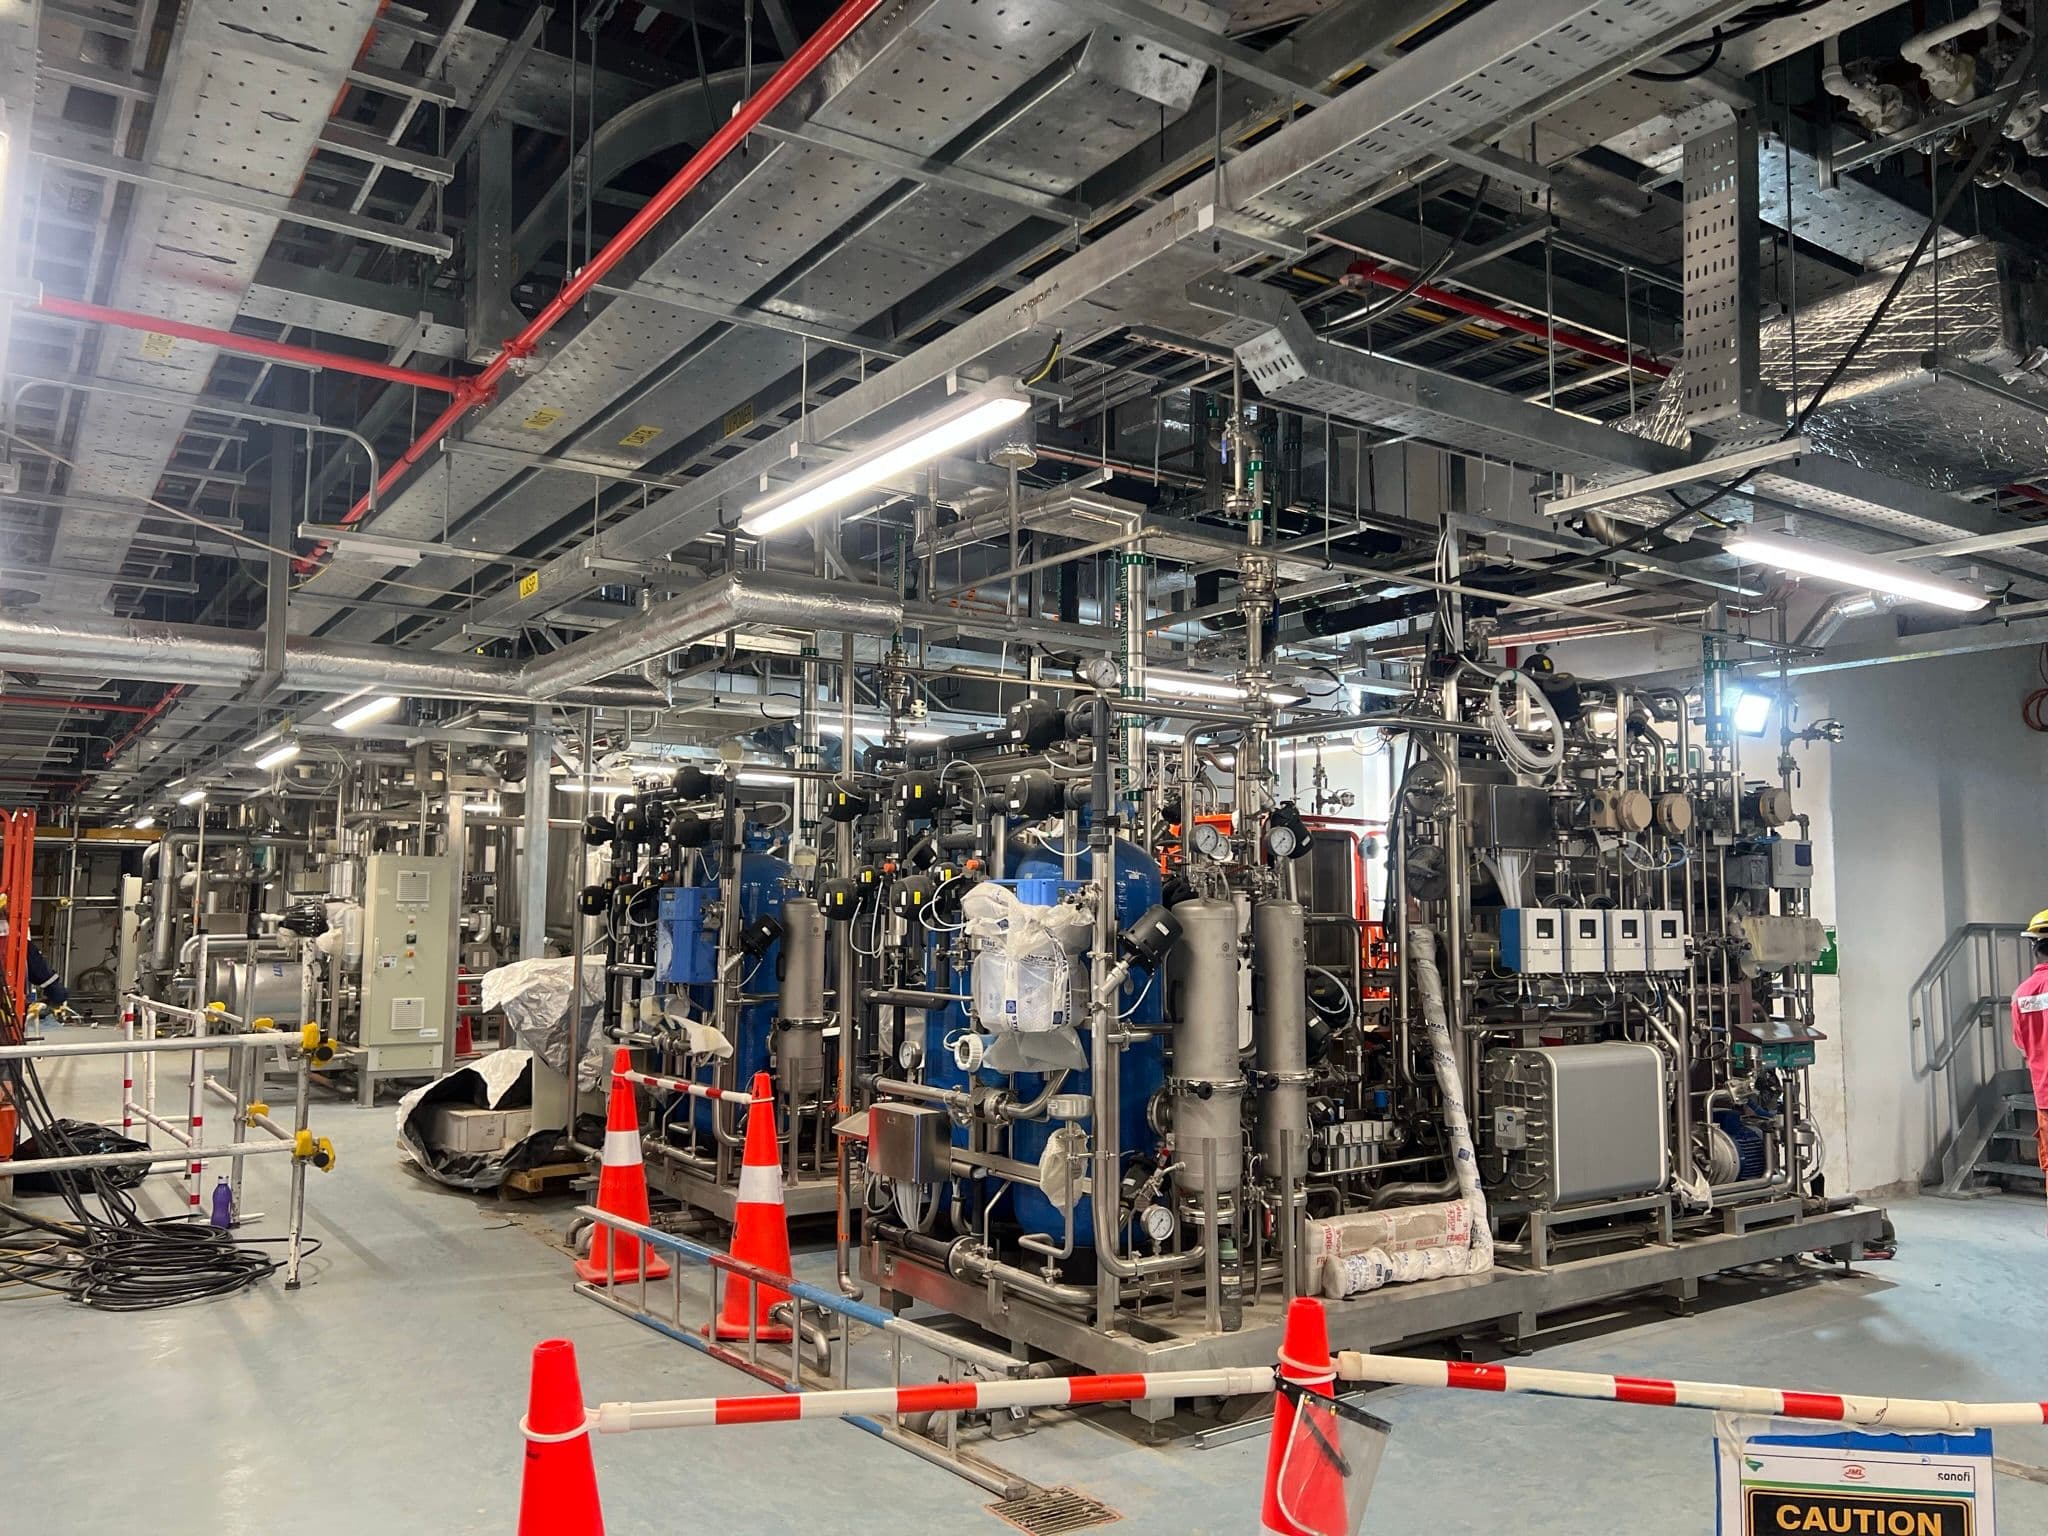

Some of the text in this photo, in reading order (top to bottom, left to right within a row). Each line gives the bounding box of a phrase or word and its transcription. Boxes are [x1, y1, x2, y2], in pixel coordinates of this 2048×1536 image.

[1120, 567, 1128, 614] PURIFIED
[1120, 616, 1128, 652] WATER
[1415, 1237, 1439, 1248] FRAGILE
[1937, 1471, 1971, 1483] sanofi
[1776, 1504, 1942, 1536] CAUTION
